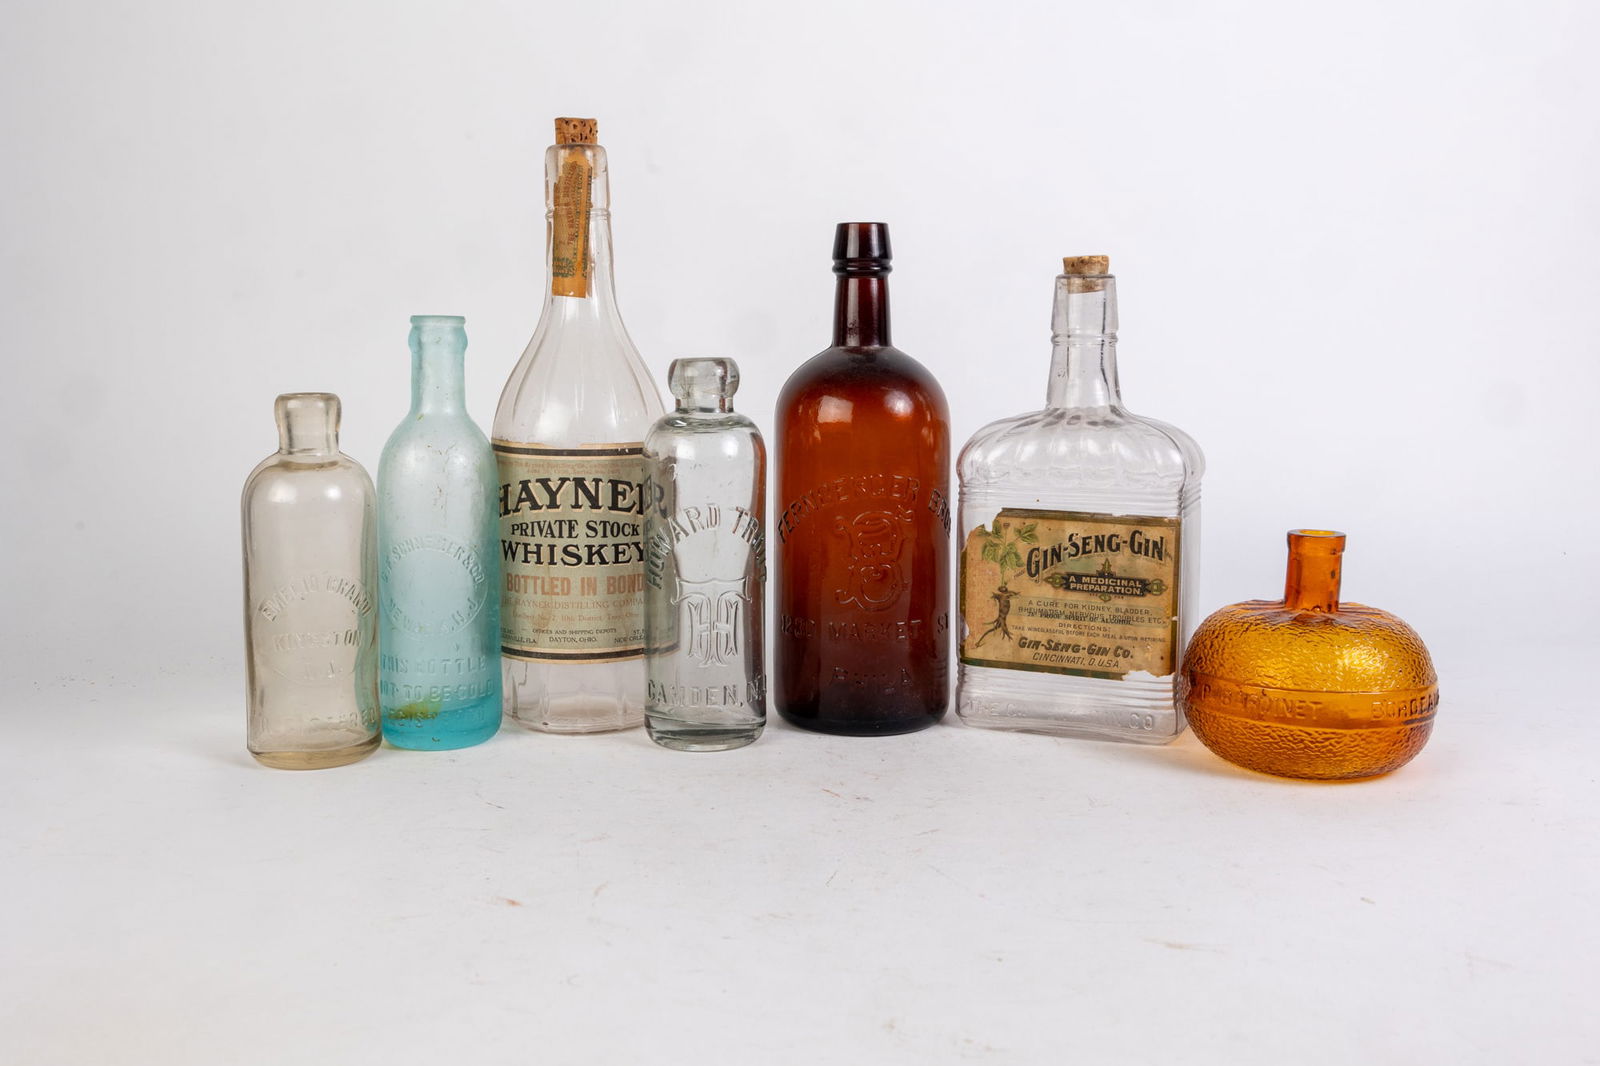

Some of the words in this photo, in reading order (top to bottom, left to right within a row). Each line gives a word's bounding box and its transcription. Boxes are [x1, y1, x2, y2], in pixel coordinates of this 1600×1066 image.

[511, 519, 579, 539] PRIVATE
[585, 520, 640, 538] STOCK
[501, 539, 645, 567] WHISKEY
[647, 503, 721, 590] HOWARD
[1026, 529, 1165, 579] GIN-SENG-GIN
[507, 573, 571, 596] BOTTLED
[580, 577, 597, 596] IN
[607, 573, 645, 595] BOND
[1069, 575, 1077, 583] A
[1082, 576, 1143, 588] MEDICINAL
[1069, 583, 1144, 596] PREPARATION.
[554, 600, 609, 609] DISTILLING
[1064, 602, 1079, 610] FOR
[1069, 610, 1104, 619] NERVOUS
[1108, 614, 1145, 623] TROUBLES
[828, 618, 922, 642] MARKET
[1058, 622, 1112, 632] DIRECTIONS:
[1018, 636, 1112, 657] GIN-SENG-GIN
[381, 654, 409, 674] THIS
[416, 655, 487, 676] BOTTLE
[402, 684, 423, 702] TO
[429, 685, 452, 702] BE
